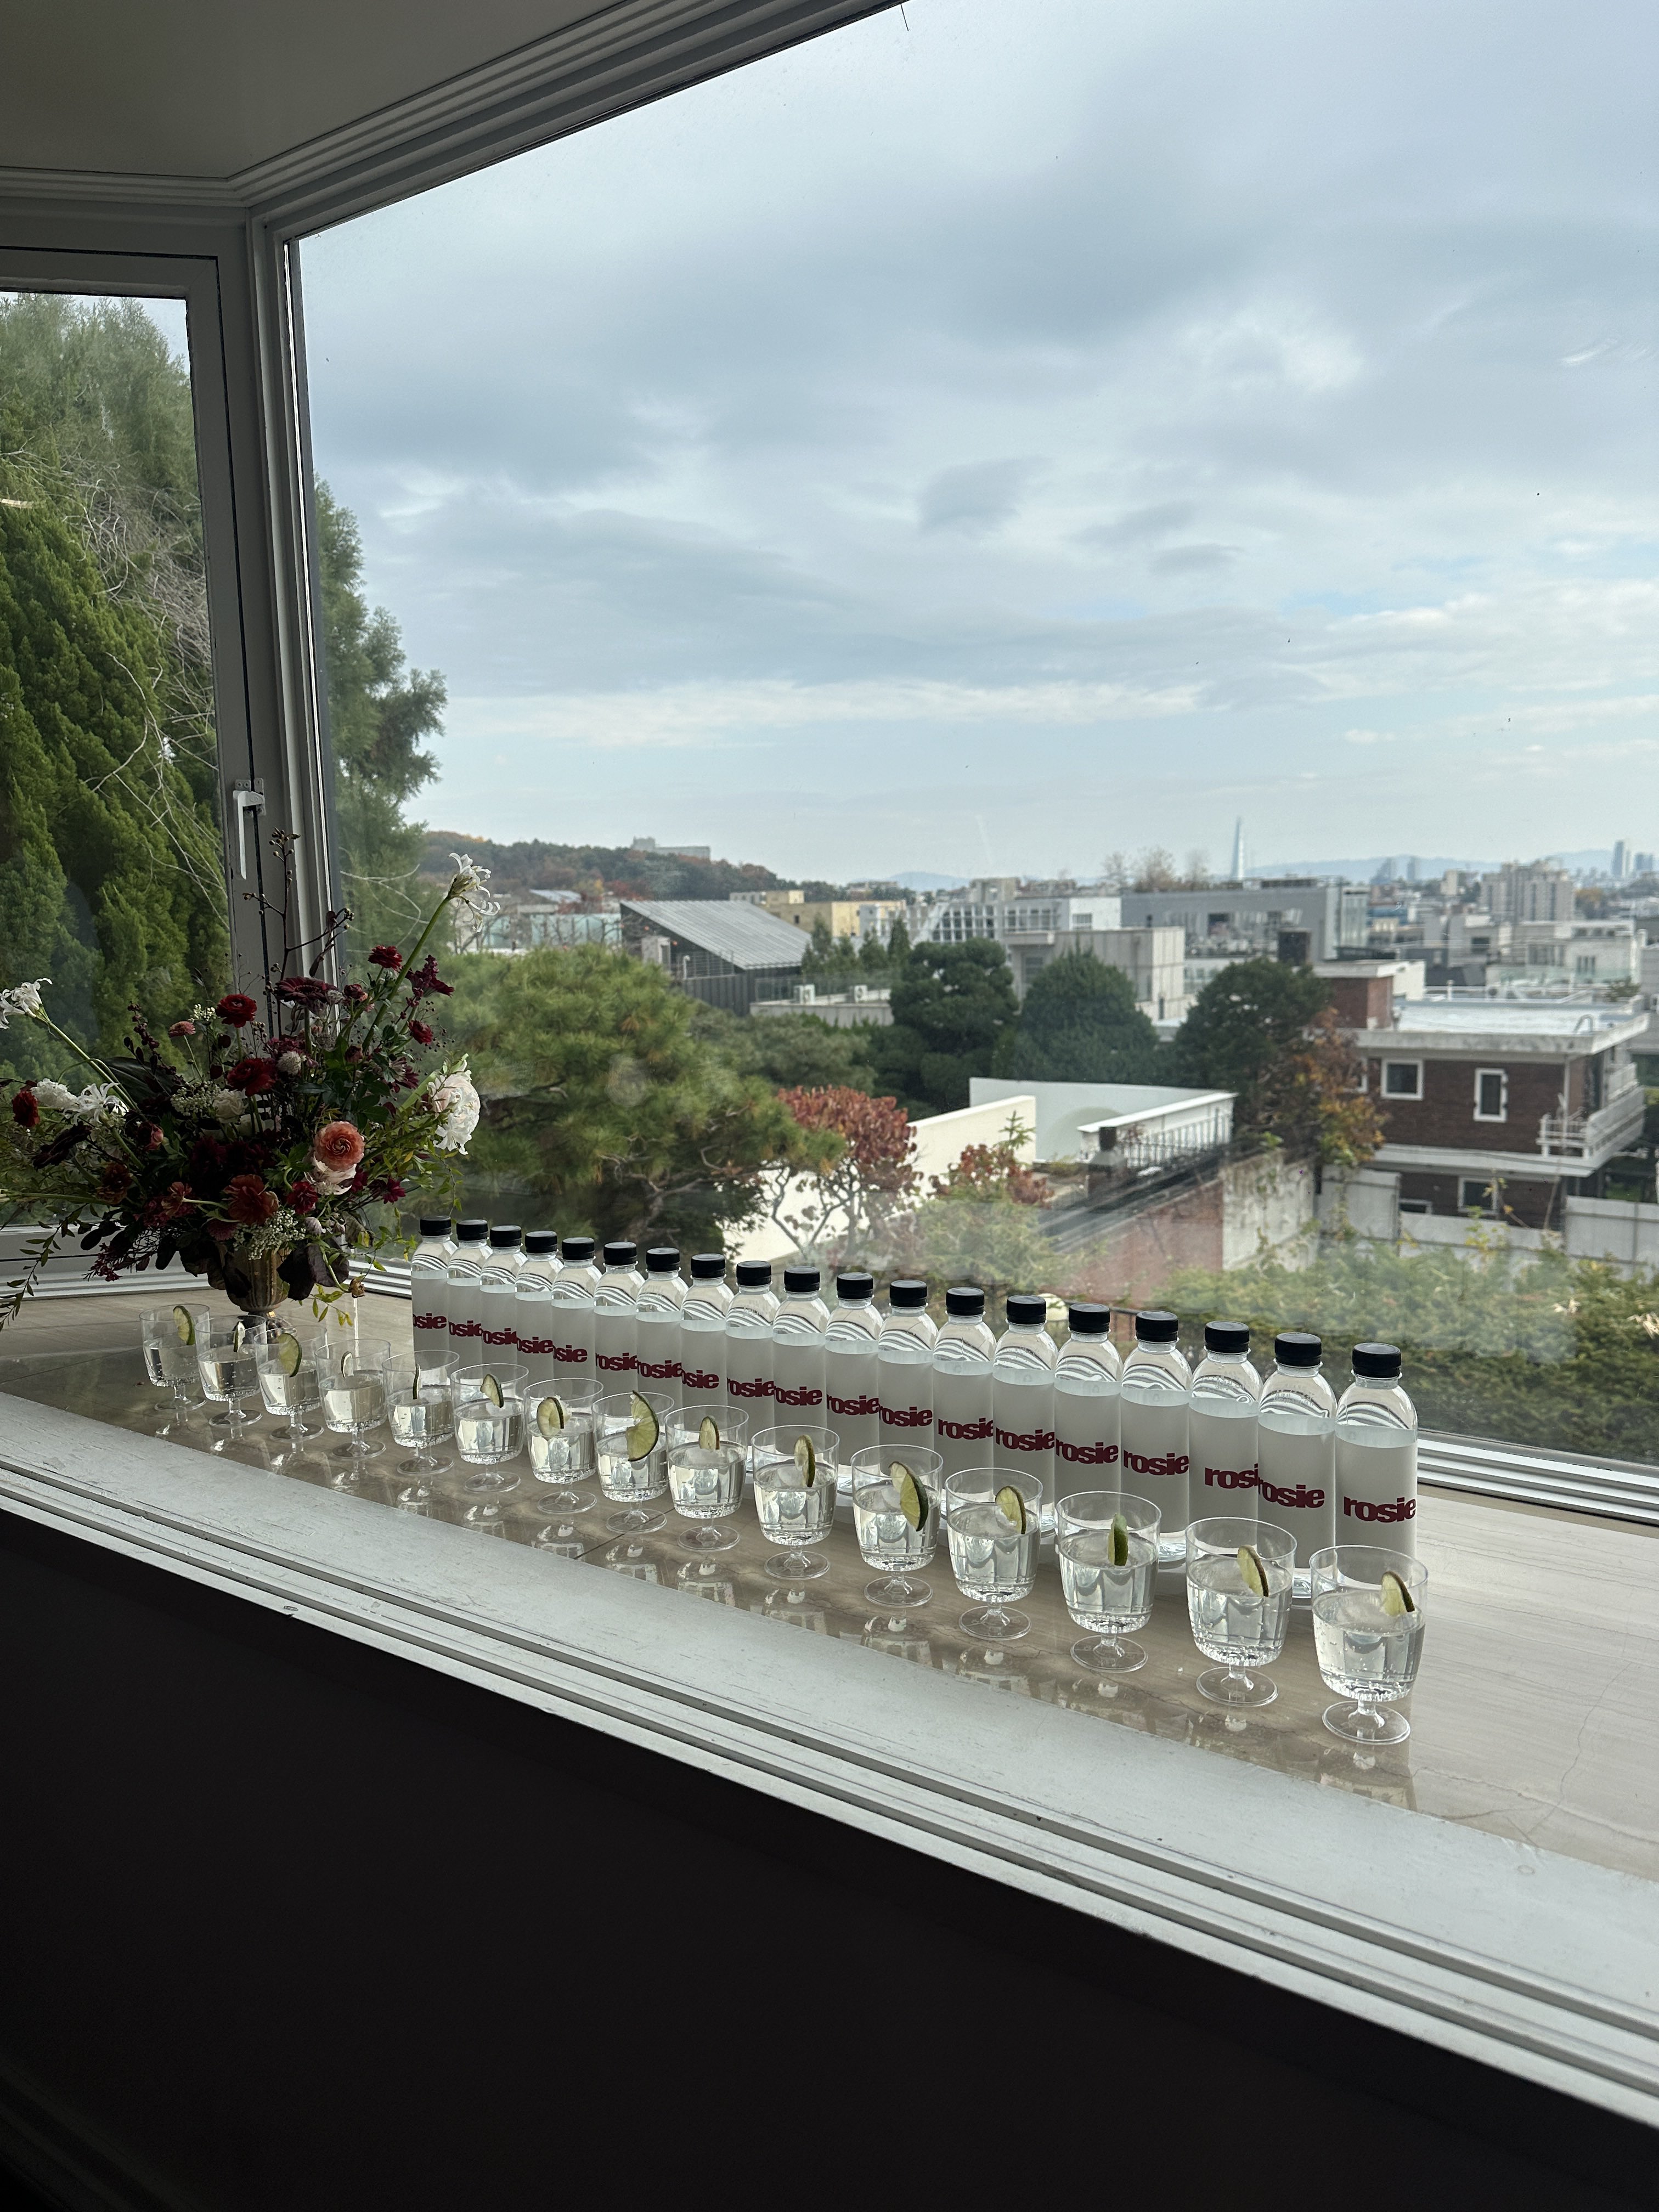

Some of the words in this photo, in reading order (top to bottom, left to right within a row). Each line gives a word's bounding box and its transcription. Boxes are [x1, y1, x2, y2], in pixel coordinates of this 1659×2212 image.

[449, 1320, 482, 1337] osie
[517, 1336, 553, 1354] osie
[681, 1369, 719, 1389] osie
[827, 1393, 879, 1415] rosie
[996, 1427, 1054, 1451] rosie
[1056, 1438, 1119, 1464] rosie
[1124, 1449, 1189, 1476] rosie
[1205, 1463, 1259, 1489] rosi
[1344, 1496, 1416, 1523] rosie
